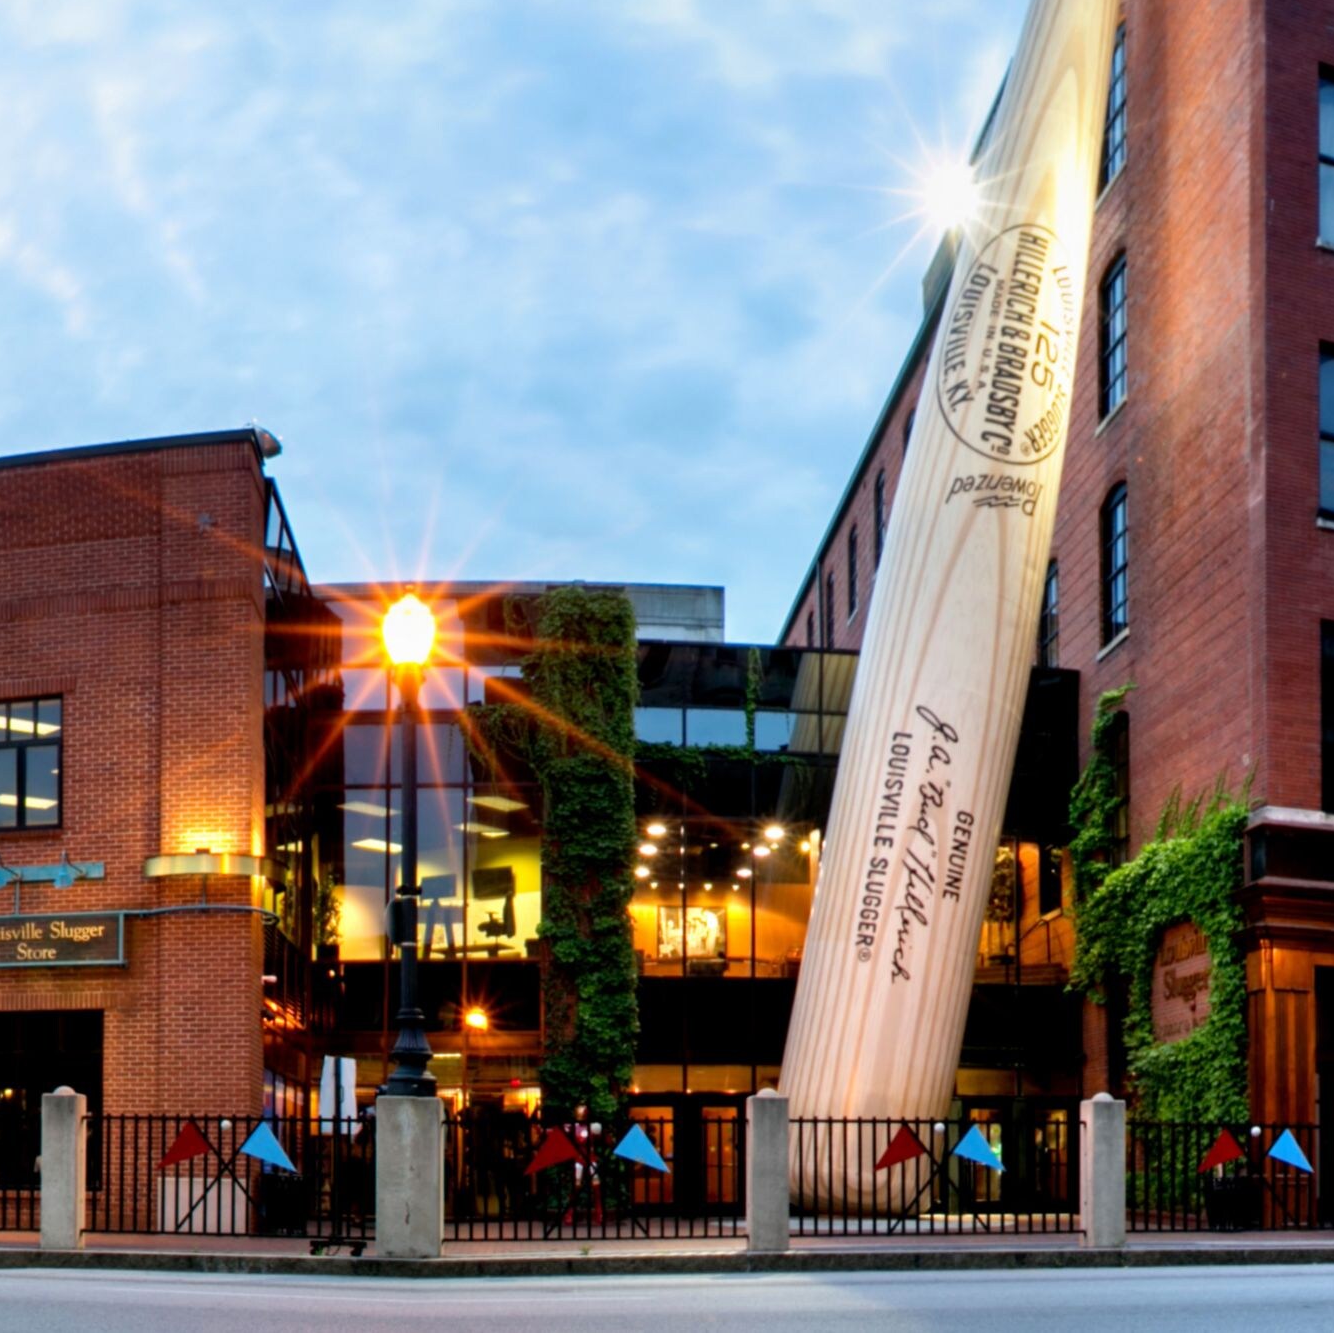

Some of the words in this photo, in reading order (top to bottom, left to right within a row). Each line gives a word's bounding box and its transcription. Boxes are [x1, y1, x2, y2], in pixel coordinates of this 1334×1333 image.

[990, 279, 1005, 316] MADE
[1004, 231, 1048, 326] HILLERICH
[986, 326, 997, 339] IN
[1001, 325, 1031, 341] &
[1031, 321, 1060, 391] 125
[946, 379, 974, 412] KY.
[984, 341, 1028, 433] BRADSBY
[945, 474, 1043, 516] Powerized
[874, 731, 913, 848] LOUISVILLE
[942, 810, 975, 903] GENUINE
[49, 920, 106, 942] Slugger
[16, 943, 57, 960] Store
